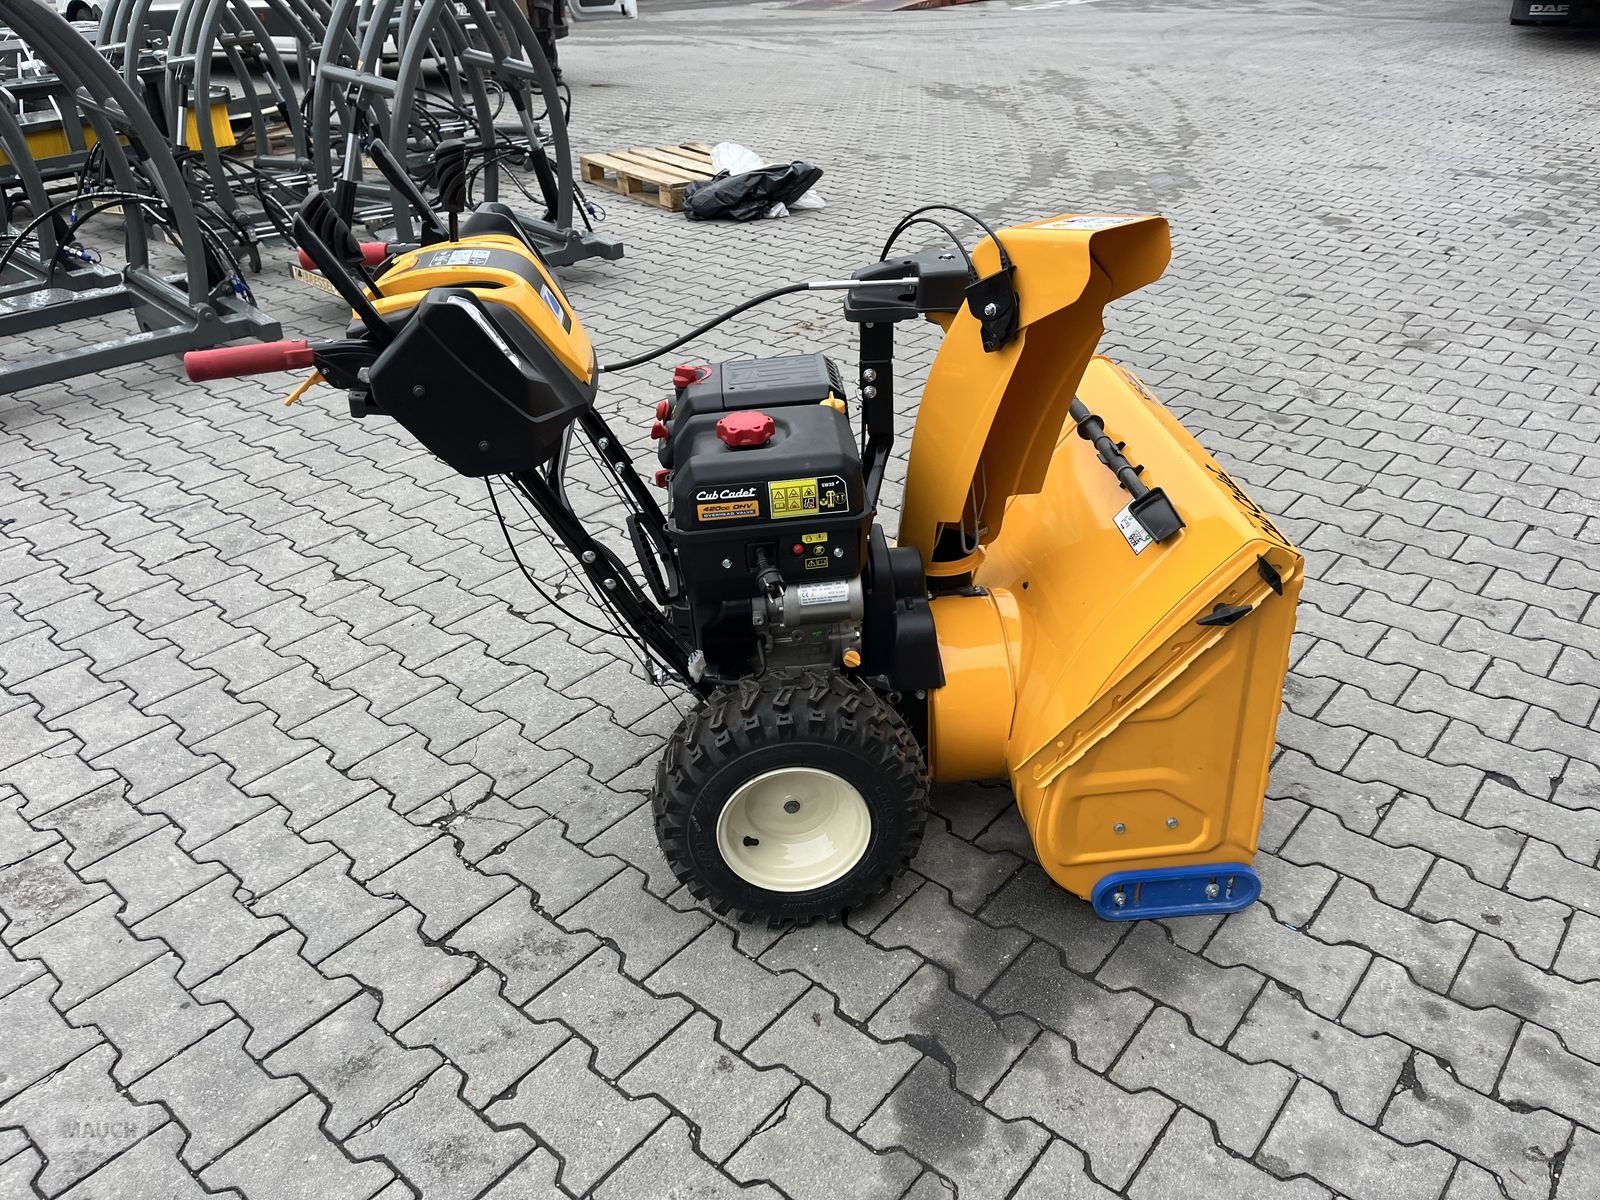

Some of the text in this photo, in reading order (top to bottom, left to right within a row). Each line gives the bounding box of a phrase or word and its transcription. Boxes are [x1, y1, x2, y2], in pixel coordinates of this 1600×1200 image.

[1529, 4, 1569, 12] DAF
[696, 487, 757, 501] Cub Cadet
